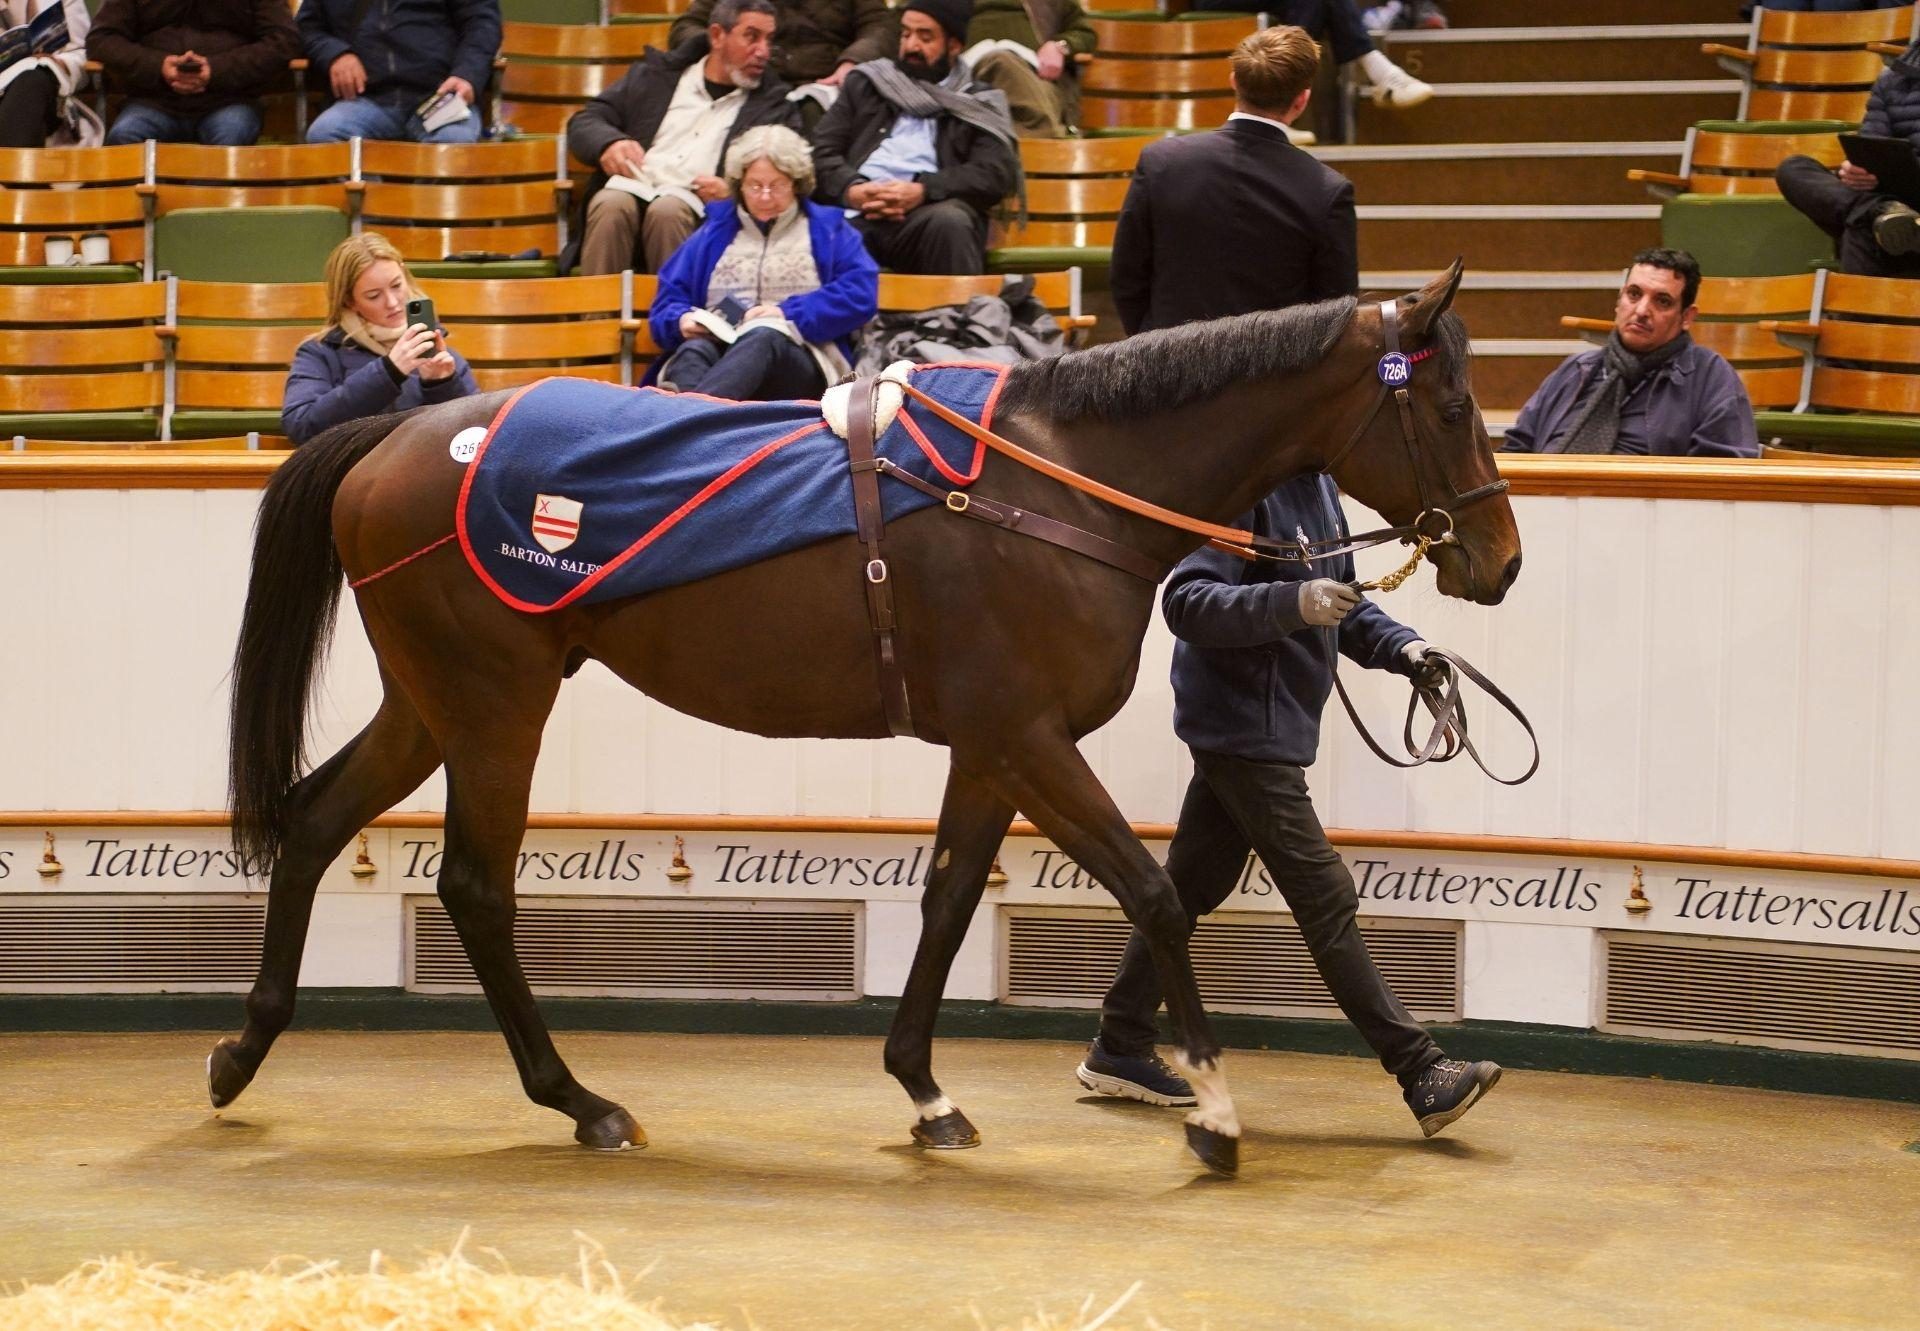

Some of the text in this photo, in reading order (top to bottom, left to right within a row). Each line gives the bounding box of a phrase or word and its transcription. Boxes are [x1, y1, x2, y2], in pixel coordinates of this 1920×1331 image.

[1384, 362, 1408, 380] 726A
[455, 442, 482, 457] 726
[501, 543, 557, 569] BARTON
[85, 839, 271, 878] Tattersa
[401, 840, 645, 881] Tarsalls
[1353, 860, 1602, 912] Tattersalls
[1674, 877, 1920, 936] Tattersalls
